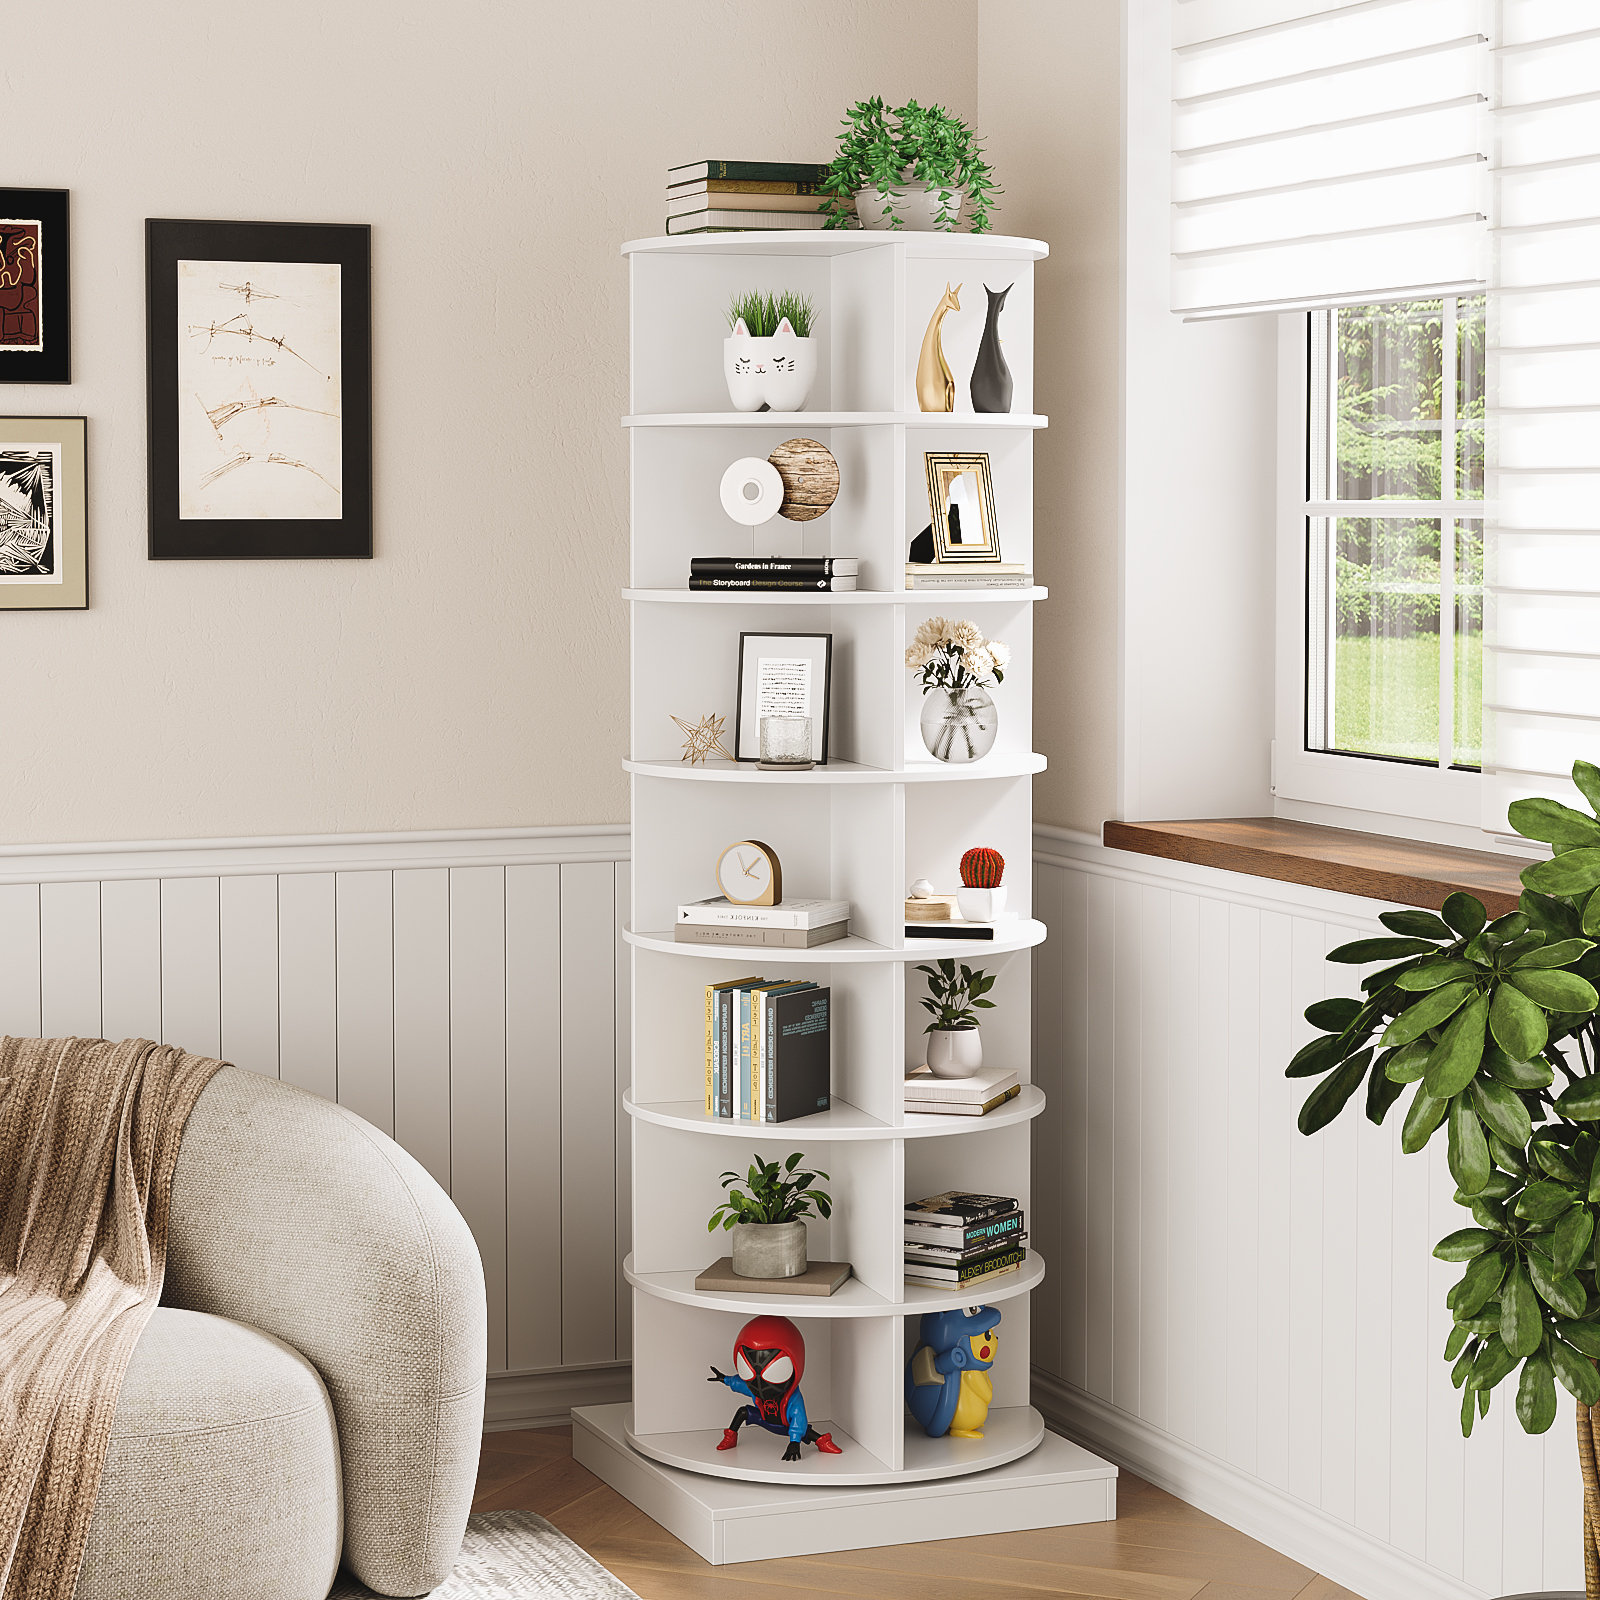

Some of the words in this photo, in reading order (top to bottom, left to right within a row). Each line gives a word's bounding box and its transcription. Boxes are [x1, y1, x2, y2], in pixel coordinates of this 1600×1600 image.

[735, 562, 761, 570] Gardens
[762, 562, 769, 570] in
[770, 562, 792, 570] France
[713, 579, 750, 587] Storyboard
[752, 580, 776, 588] Design
[966, 1227, 986, 1240] MODERN
[986, 1217, 1018, 1238] WOMEN
[959, 1263, 984, 1281] ALEXEY
[984, 1250, 1022, 1273] BRODOVITCH
